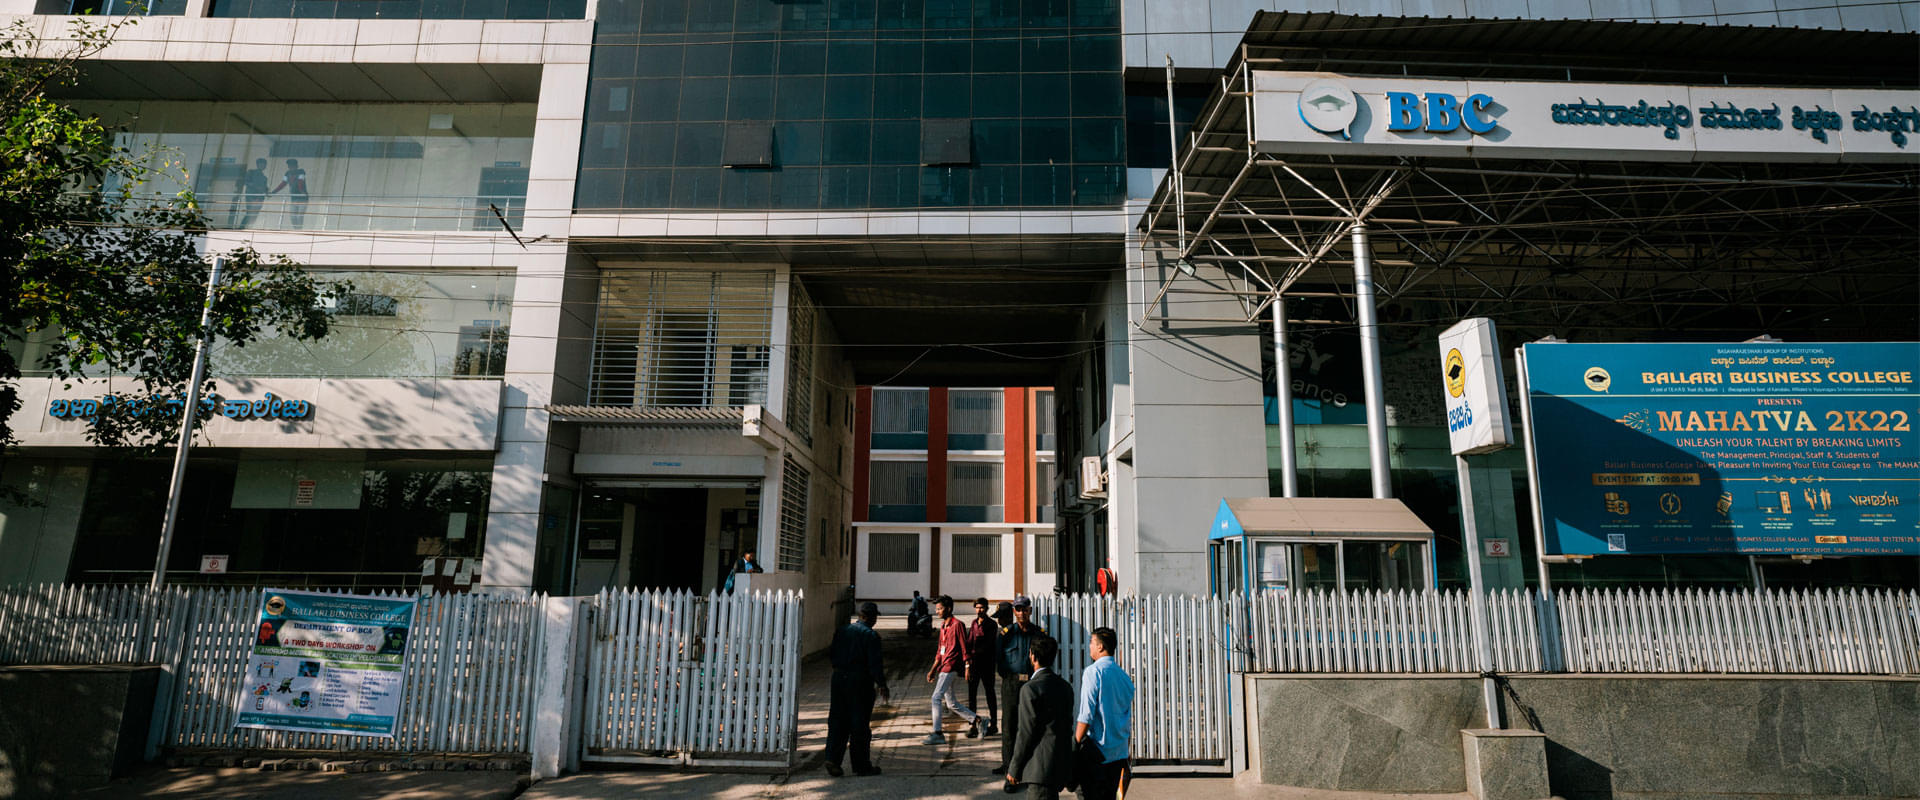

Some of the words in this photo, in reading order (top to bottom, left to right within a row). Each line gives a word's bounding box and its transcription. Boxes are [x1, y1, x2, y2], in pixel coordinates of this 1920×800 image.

[1384, 91, 1498, 133] BBC
[1641, 371, 1723, 385] BALLARI
[1729, 371, 1823, 384] BUSINESS
[1827, 371, 1913, 384] COLLEGE
[222, 391, 309, 418] ಕಾಲೇಜು
[1757, 398, 1803, 406] PRESENTS
[1656, 410, 1817, 432] MAHATVA
[1825, 410, 1911, 432] 2K22
[1676, 438, 1722, 448] UNLEASH
[1725, 438, 1753, 448] YOUR
[1755, 438, 1794, 448] TALENT
[1796, 438, 1809, 448] BY
[1812, 438, 1864, 448] BREAKING
[1866, 438, 1901, 448] LIMITS
[1701, 451, 1715, 459] The
[1805, 451, 1824, 459] Staff
[1827, 451, 1834, 459] &
[1835, 451, 1870, 460] Students
[1872, 451, 1880, 459] of
[1630, 460, 1663, 469] Business
[1696, 461, 1716, 470] Takes
[1718, 461, 1751, 470] Pleasure
[1753, 461, 1760, 470] In
[1762, 461, 1792, 471] Inviting
[1793, 461, 1810, 470] Your
[1812, 461, 1830, 470] Elite
[1832, 461, 1861, 471] College
[1863, 461, 1871, 470] to
[1877, 461, 1892, 470] The
[1646, 475, 1656, 483] AT
[292, 607, 328, 617] BALLARI
[329, 609, 369, 620] BUSINESS
[370, 613, 406, 622] COLLEGE
[294, 623, 344, 633] DEPARTMENT
[325, 642, 364, 650] WORKSHOP
